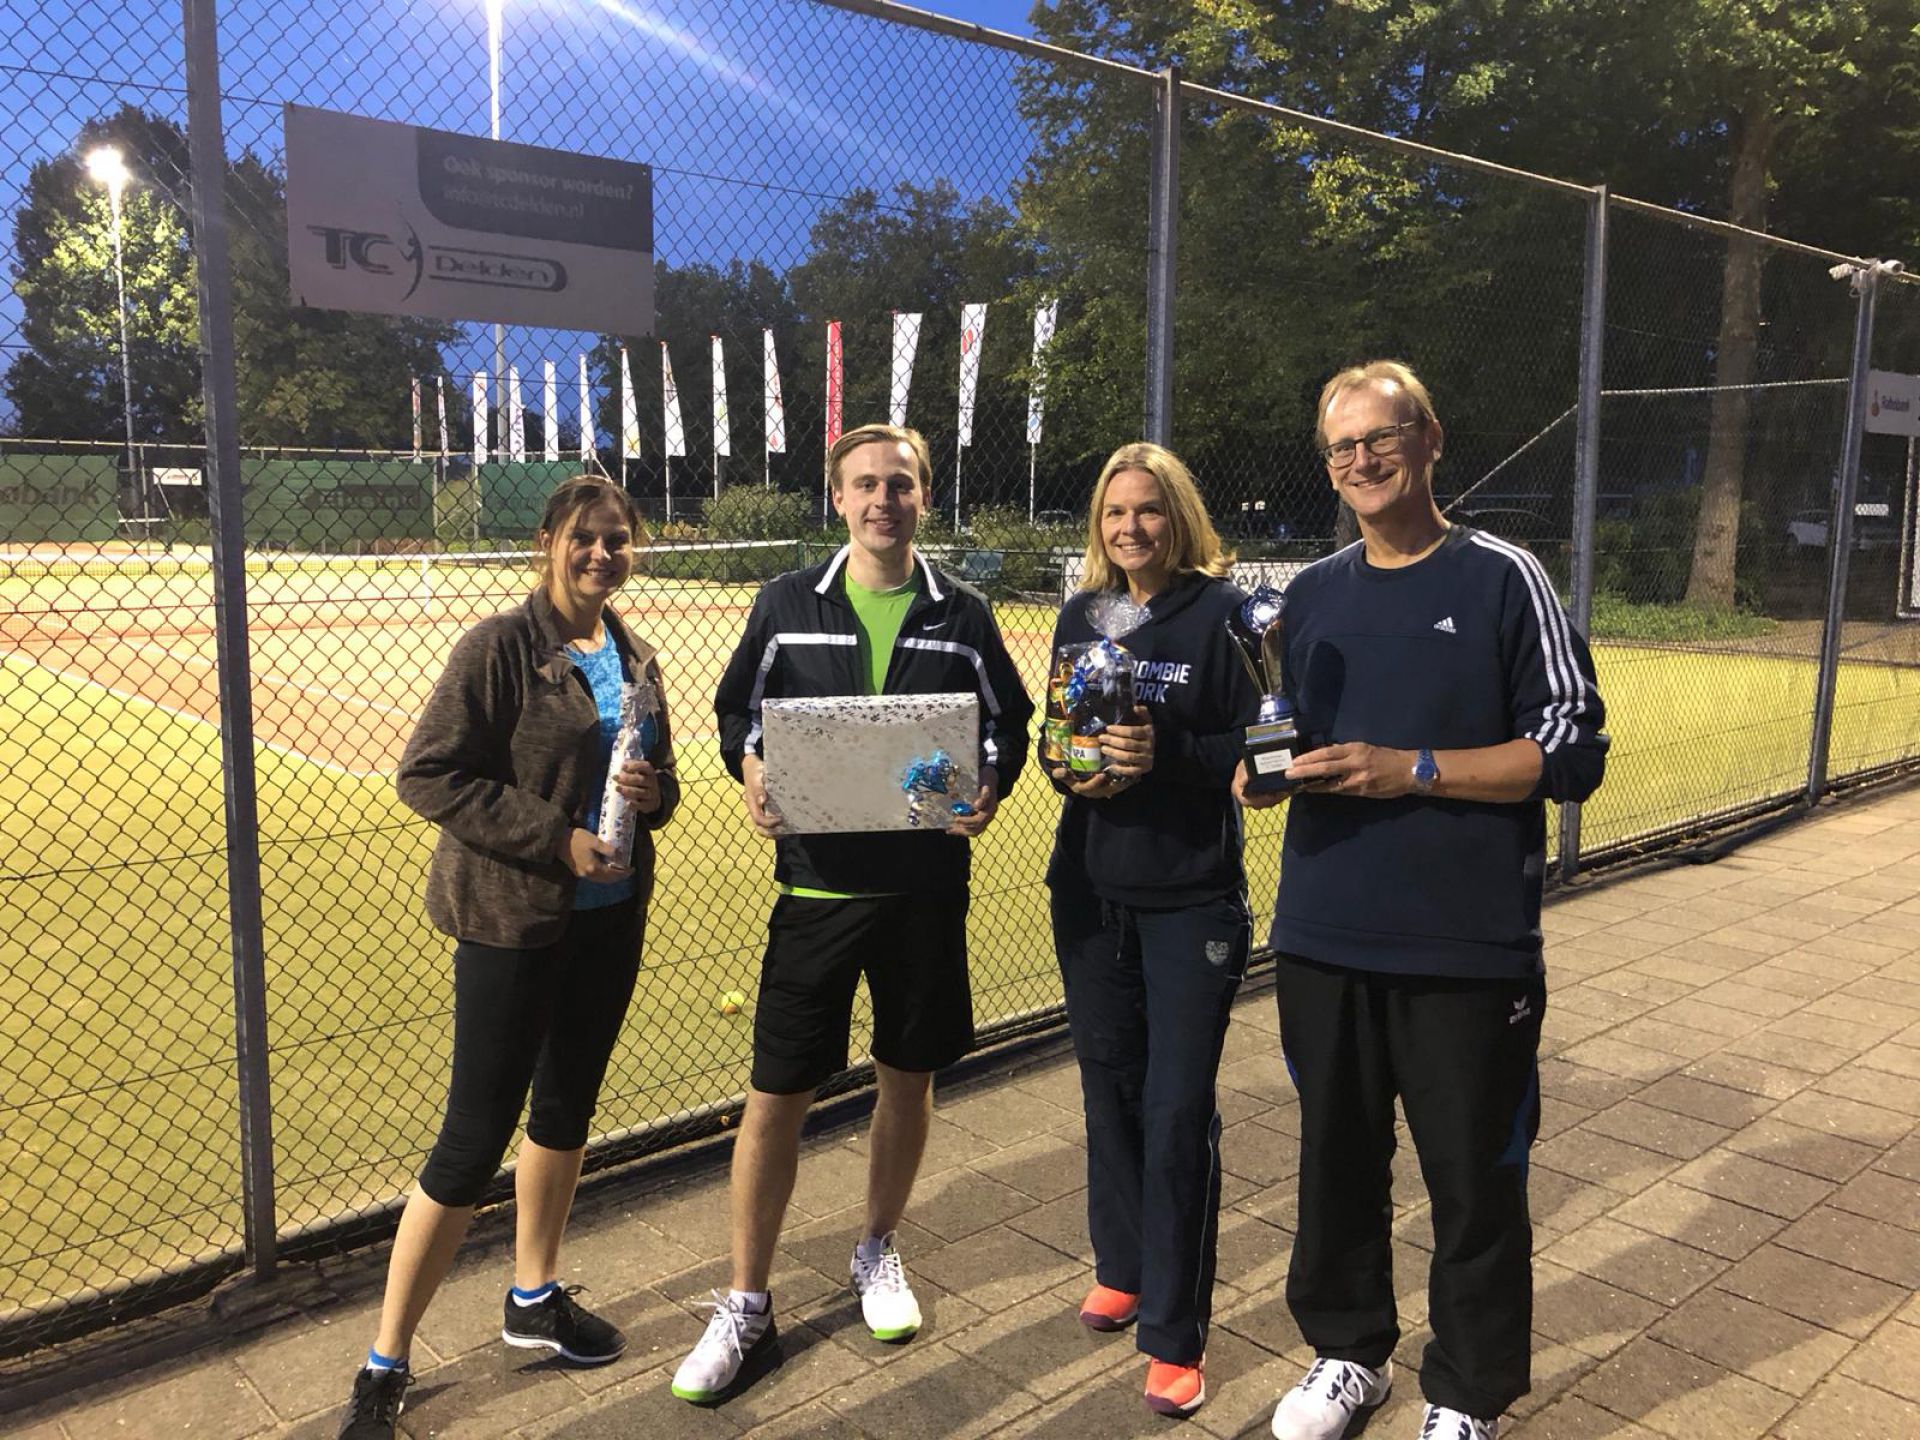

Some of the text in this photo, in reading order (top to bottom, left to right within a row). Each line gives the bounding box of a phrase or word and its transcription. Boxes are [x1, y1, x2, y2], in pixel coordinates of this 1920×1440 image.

[444, 155, 634, 200] Ook sponsor worden?
[306, 224, 394, 276] TC
